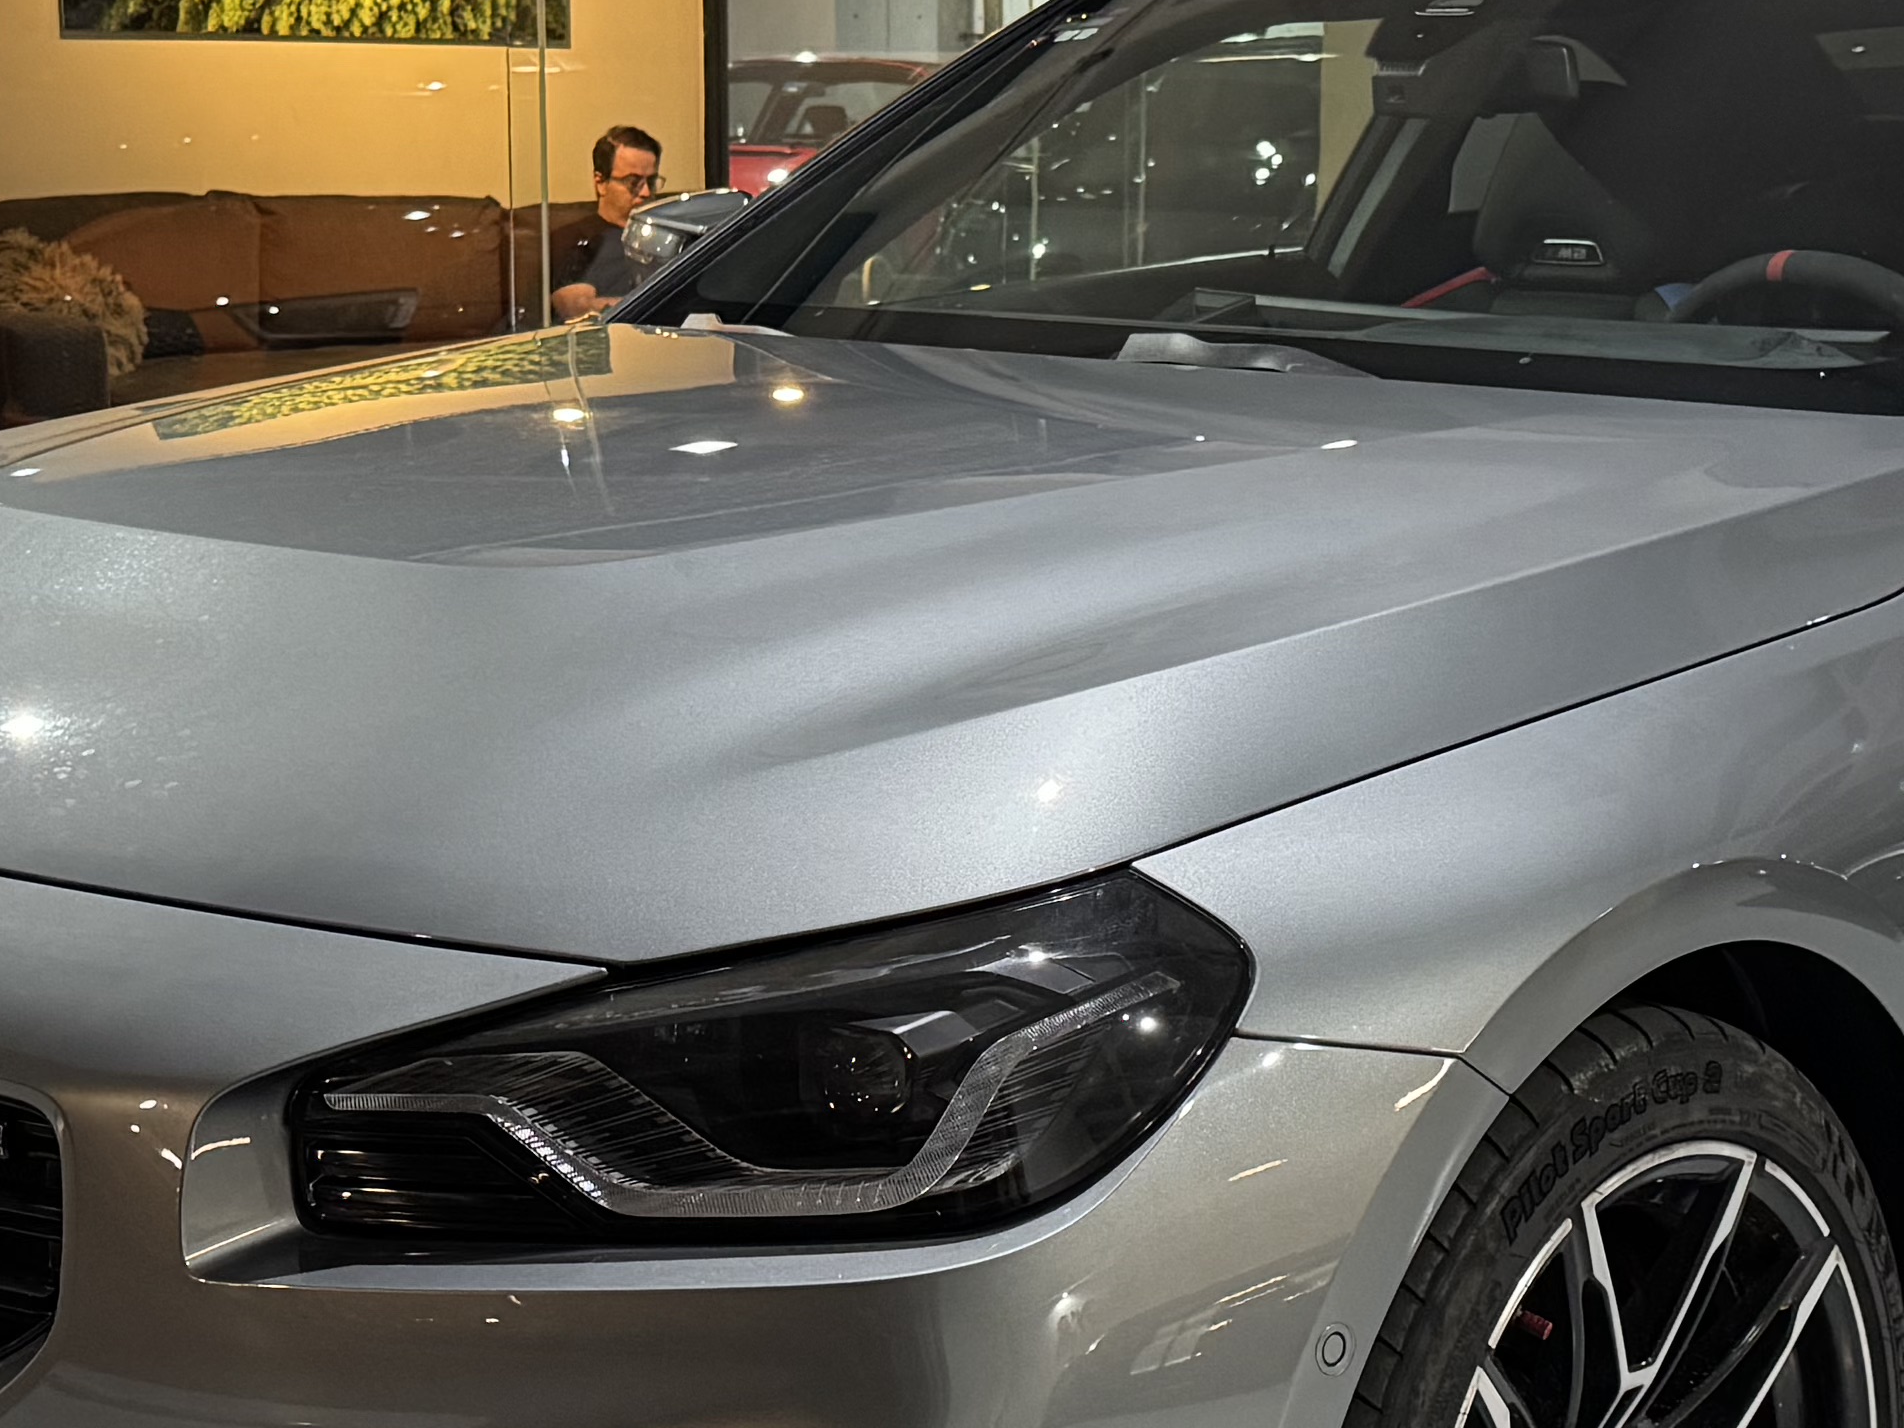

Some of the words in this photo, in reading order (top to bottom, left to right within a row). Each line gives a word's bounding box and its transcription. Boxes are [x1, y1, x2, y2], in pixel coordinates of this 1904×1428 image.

[1500, 1141, 1569, 1246] Pilot
[1570, 1080, 1647, 1165] Sport
[1652, 1069, 1697, 1105] Cup
[1703, 1060, 1723, 1095] 2
